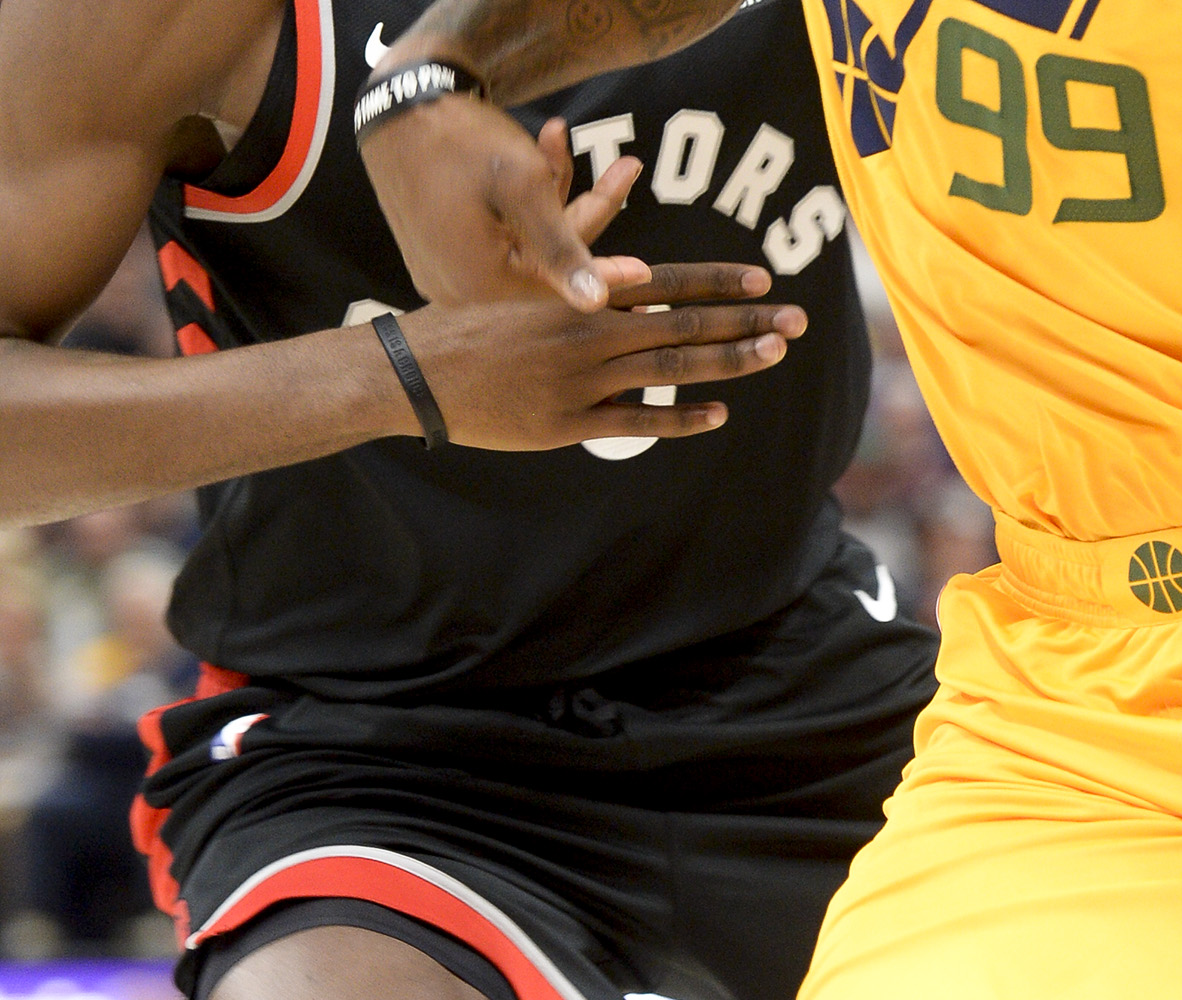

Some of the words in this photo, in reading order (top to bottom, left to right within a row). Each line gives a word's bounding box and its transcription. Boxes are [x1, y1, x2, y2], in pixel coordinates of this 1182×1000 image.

[390, 70, 417, 104] TO
[936, 17, 1166, 224] 99
[571, 108, 848, 275] TORS
